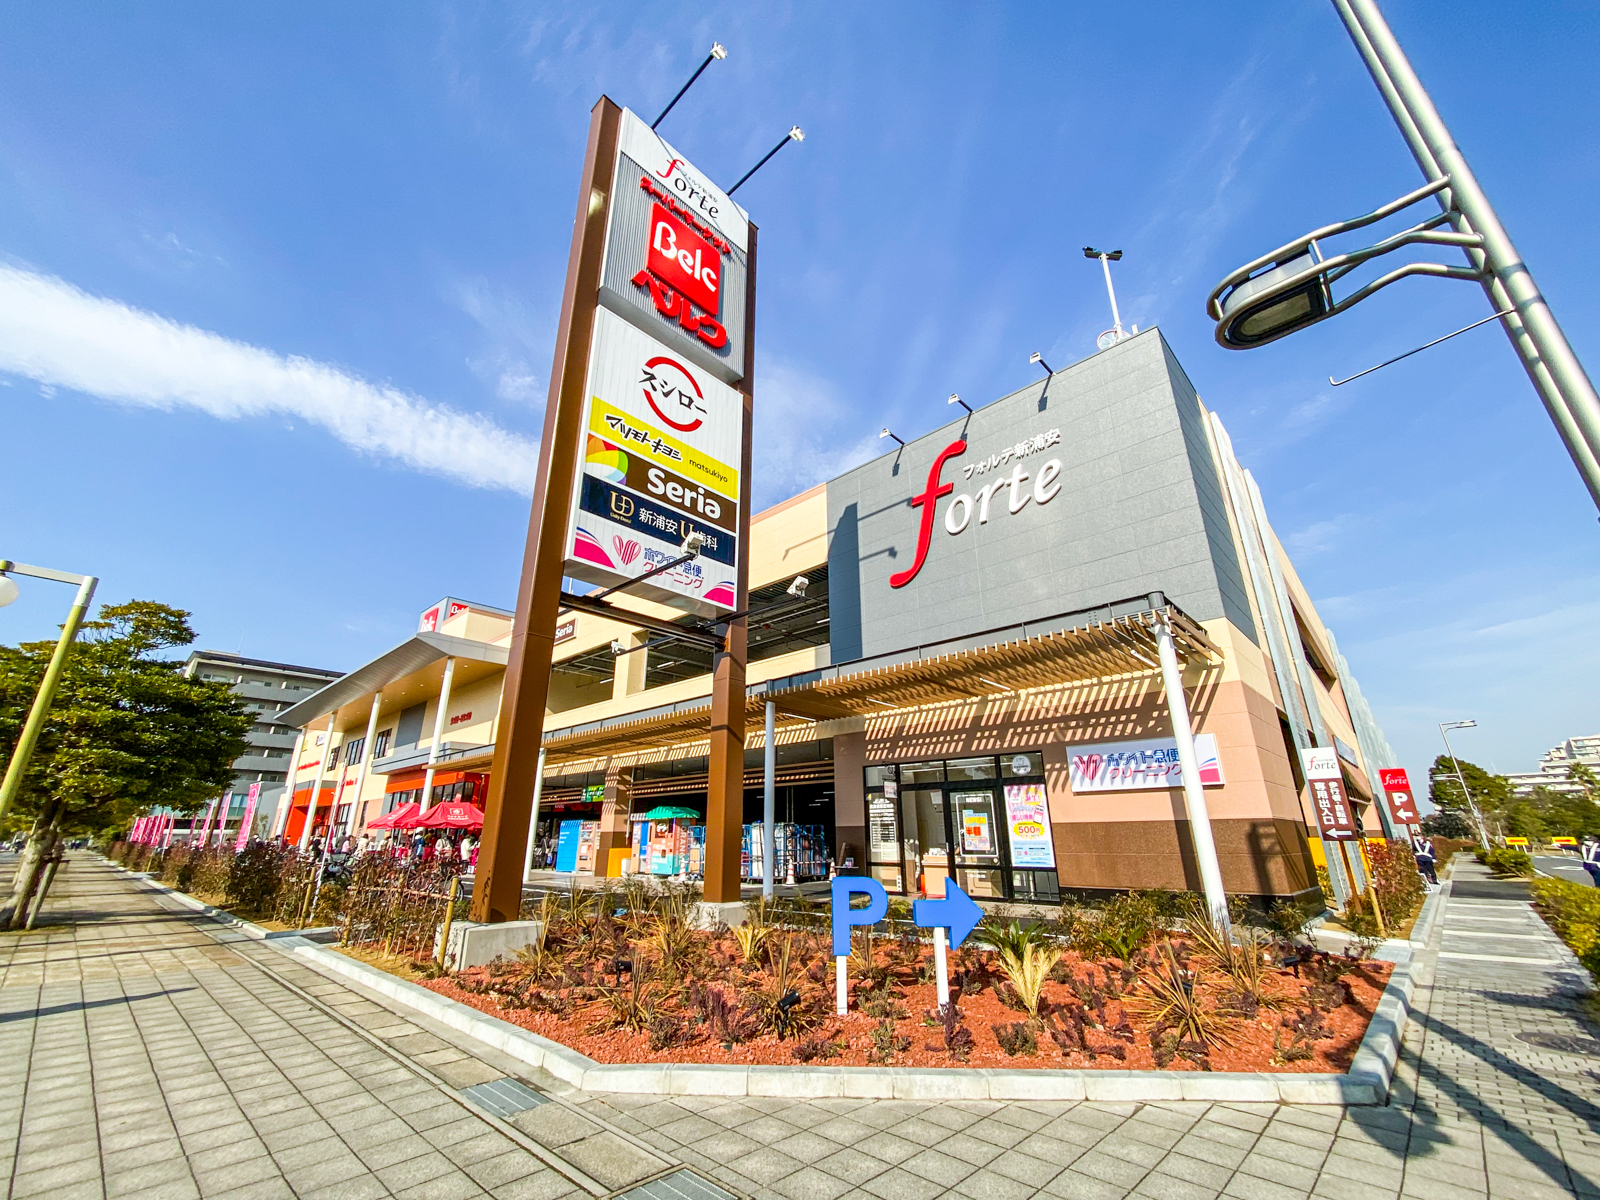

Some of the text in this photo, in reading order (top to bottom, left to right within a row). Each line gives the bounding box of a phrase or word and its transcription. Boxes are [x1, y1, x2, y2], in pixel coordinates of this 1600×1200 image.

[656, 159, 719, 219] forte
[653, 221, 717, 293] Belc
[631, 269, 727, 349] ベルク
[638, 368, 708, 415] スシロー
[605, 414, 682, 462] マツモトキヨシ
[963, 428, 1061, 480] フォルテ新浦安
[647, 467, 721, 519] Seria
[689, 459, 729, 483] matsukiyo
[889, 439, 1062, 589] forte
[644, 547, 702, 579] ホワイ急便
[555, 623, 573, 639] Seria
[1107, 748, 1180, 767] ホワイト急便
[1307, 756, 1337, 771] forte
[1383, 774, 1407, 786] forte
[1313, 782, 1335, 825] 専用出入口
[1391, 792, 1408, 806] P
[1018, 825, 1041, 835] 500円
[831, 876, 889, 956] P
